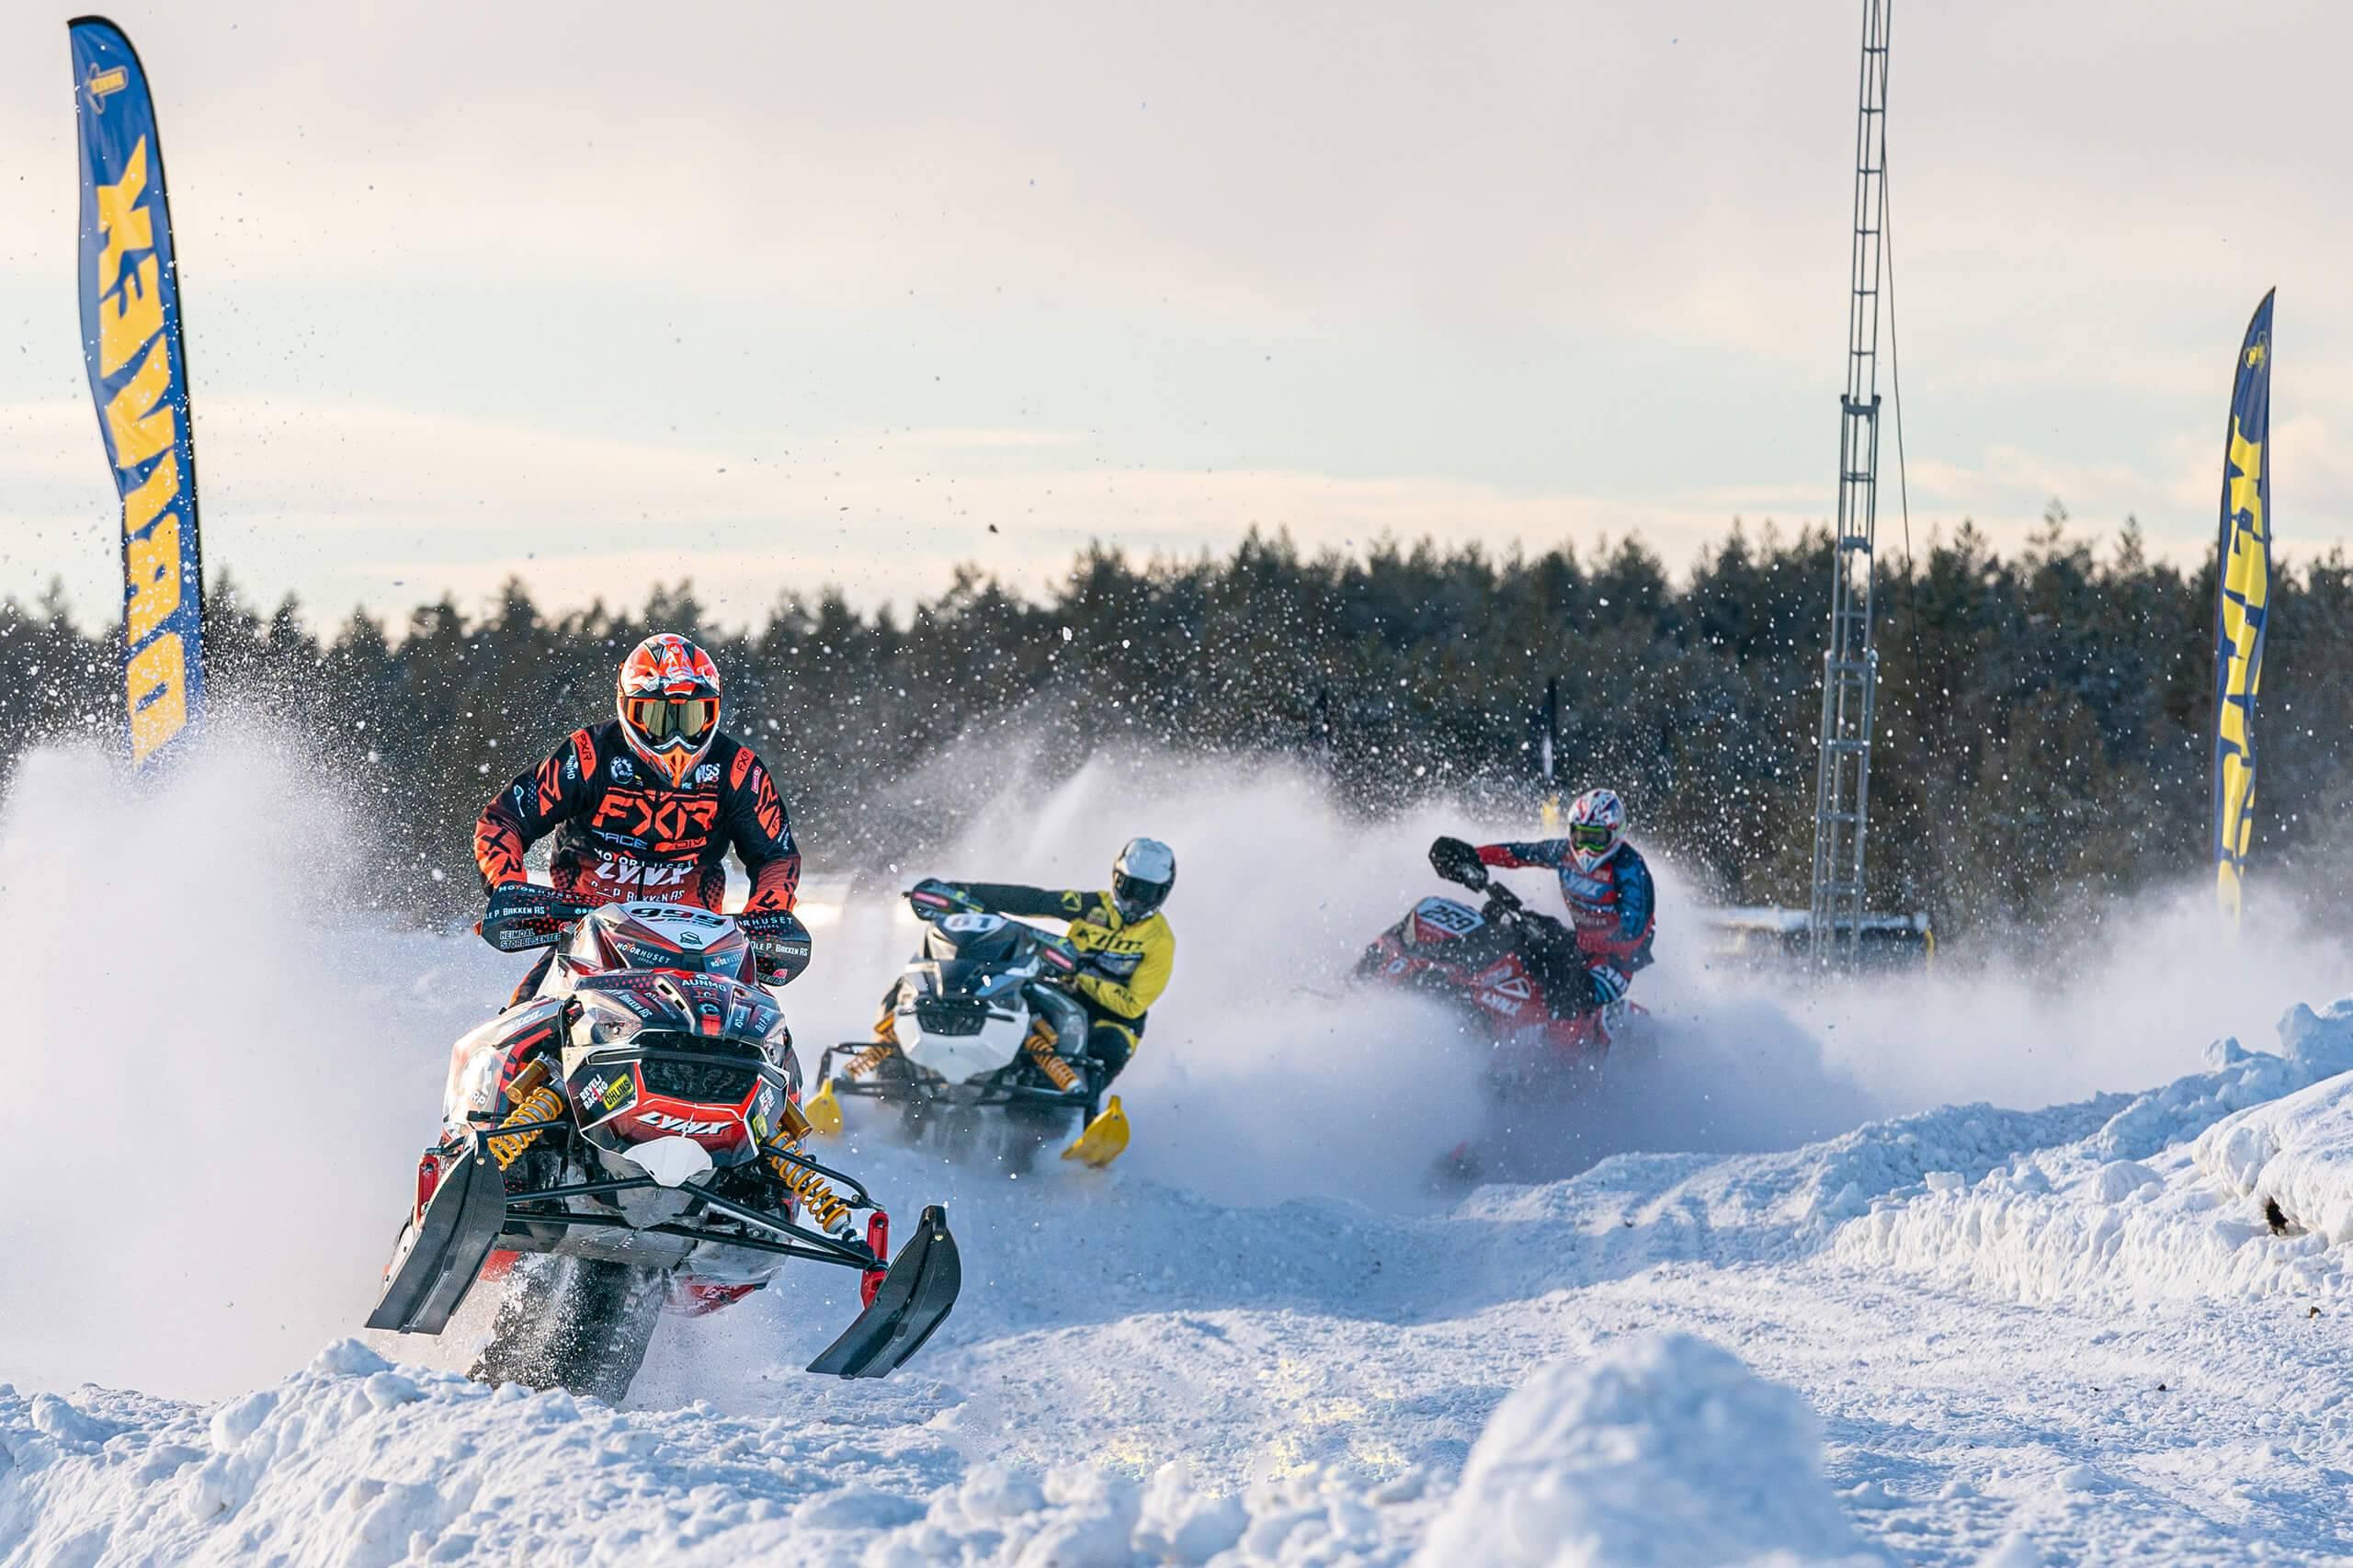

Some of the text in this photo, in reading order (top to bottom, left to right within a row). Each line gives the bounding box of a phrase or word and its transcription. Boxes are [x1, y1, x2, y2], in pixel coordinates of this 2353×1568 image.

[579, 733, 593, 761] FXR
[736, 750, 751, 773] FXR
[591, 793, 719, 841] FXR
[594, 861, 695, 886] LYNX
[626, 891, 669, 903] BKKEN
[534, 905, 546, 915] AS
[499, 927, 535, 939] HEIMDAL
[615, 941, 672, 965] MOTORHUSET
[799, 947, 809, 957] AS
[682, 978, 728, 992] AUNMO
[632, 1110, 734, 1135] LYNX
